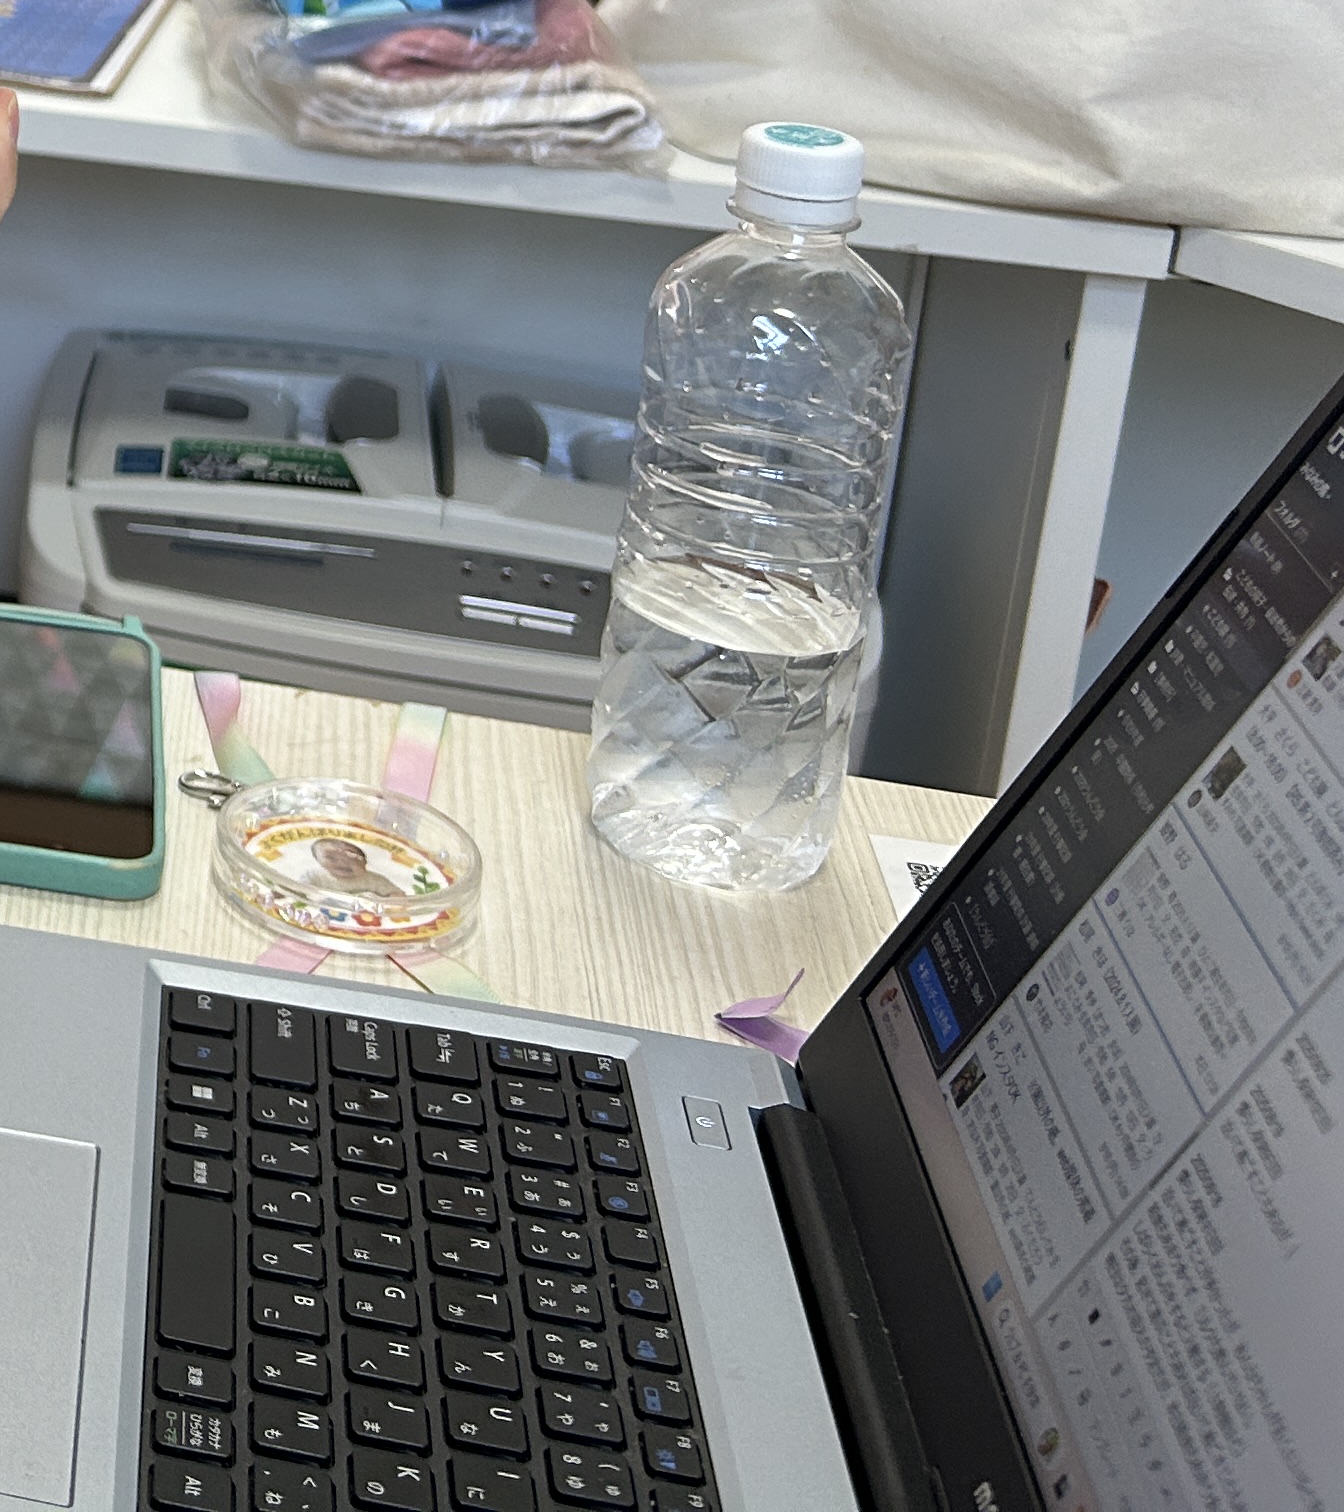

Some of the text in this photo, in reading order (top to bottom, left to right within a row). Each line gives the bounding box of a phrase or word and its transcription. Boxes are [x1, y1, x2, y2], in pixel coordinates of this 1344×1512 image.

[362, 1022, 380, 1060] Caps Lock
[598, 1057, 611, 1071] Esc
[370, 1089, 389, 1098] A
[452, 1094, 471, 1103] Q
[289, 1097, 307, 1107] Z
[510, 1096, 525, 1105] ぬ
[609, 1098, 621, 1106] F1
[345, 1102, 359, 1110] ち
[428, 1104, 443, 1113] た
[262, 1109, 275, 1118] つ
[373, 1136, 393, 1145] S
[617, 1139, 630, 1148] F2
[290, 1143, 309, 1154] X
[348, 1146, 363, 1155] と
[459, 1139, 478, 1153] W
[517, 1142, 532, 1152] ふ
[262, 1155, 277, 1164] さ
[433, 1151, 448, 1160] て
[377, 1183, 396, 1194] D
[464, 1187, 484, 1197] E
[627, 1182, 638, 1192] F3
[291, 1192, 311, 1202] C
[350, 1197, 366, 1205] し
[525, 1191, 540, 1201] あ
[262, 1203, 277, 1212] そ
[438, 1200, 452, 1209] い
[562, 1231, 580, 1239] $
[635, 1228, 648, 1238] F4
[381, 1233, 401, 1244] F
[470, 1239, 490, 1248] R
[293, 1244, 313, 1254] V
[354, 1249, 370, 1259] は
[532, 1245, 548, 1253] う
[263, 1254, 277, 1264] ひ
[443, 1252, 459, 1261] す
[571, 1284, 587, 1293] %
[645, 1279, 659, 1289] F5
[385, 1287, 405, 1299] G
[294, 1296, 314, 1306] B
[477, 1294, 497, 1304] T
[540, 1297, 557, 1306] え
[357, 1301, 373, 1311] き
[449, 1305, 465, 1316] か
[264, 1309, 279, 1318] こ
[546, 1334, 562, 1342] 6
[655, 1327, 669, 1339] F6
[580, 1340, 597, 1349] &
[389, 1343, 409, 1357] H
[296, 1352, 317, 1366] N
[483, 1352, 504, 1361] Y
[548, 1353, 565, 1364] お
[360, 1360, 377, 1369] く
[455, 1362, 471, 1373] ん
[265, 1366, 280, 1377] み
[666, 1380, 680, 1392] F7
[554, 1393, 571, 1402] 7
[388, 1402, 414, 1412] J
[490, 1408, 512, 1421] U
[557, 1414, 573, 1425] や
[298, 1412, 319, 1429] M
[363, 1421, 380, 1433] ま
[461, 1423, 478, 1435] な
[265, 1429, 282, 1439] も
[677, 1437, 691, 1448] F8
[563, 1455, 581, 1464] 8
[397, 1467, 420, 1481] K
[185, 1476, 201, 1496] Alt
[303, 1477, 316, 1487] <
[566, 1476, 585, 1488] ゆ
[367, 1482, 384, 1494] の
[467, 1487, 484, 1499] に
[266, 1491, 283, 1504] ね
[688, 1495, 704, 1507] F9
